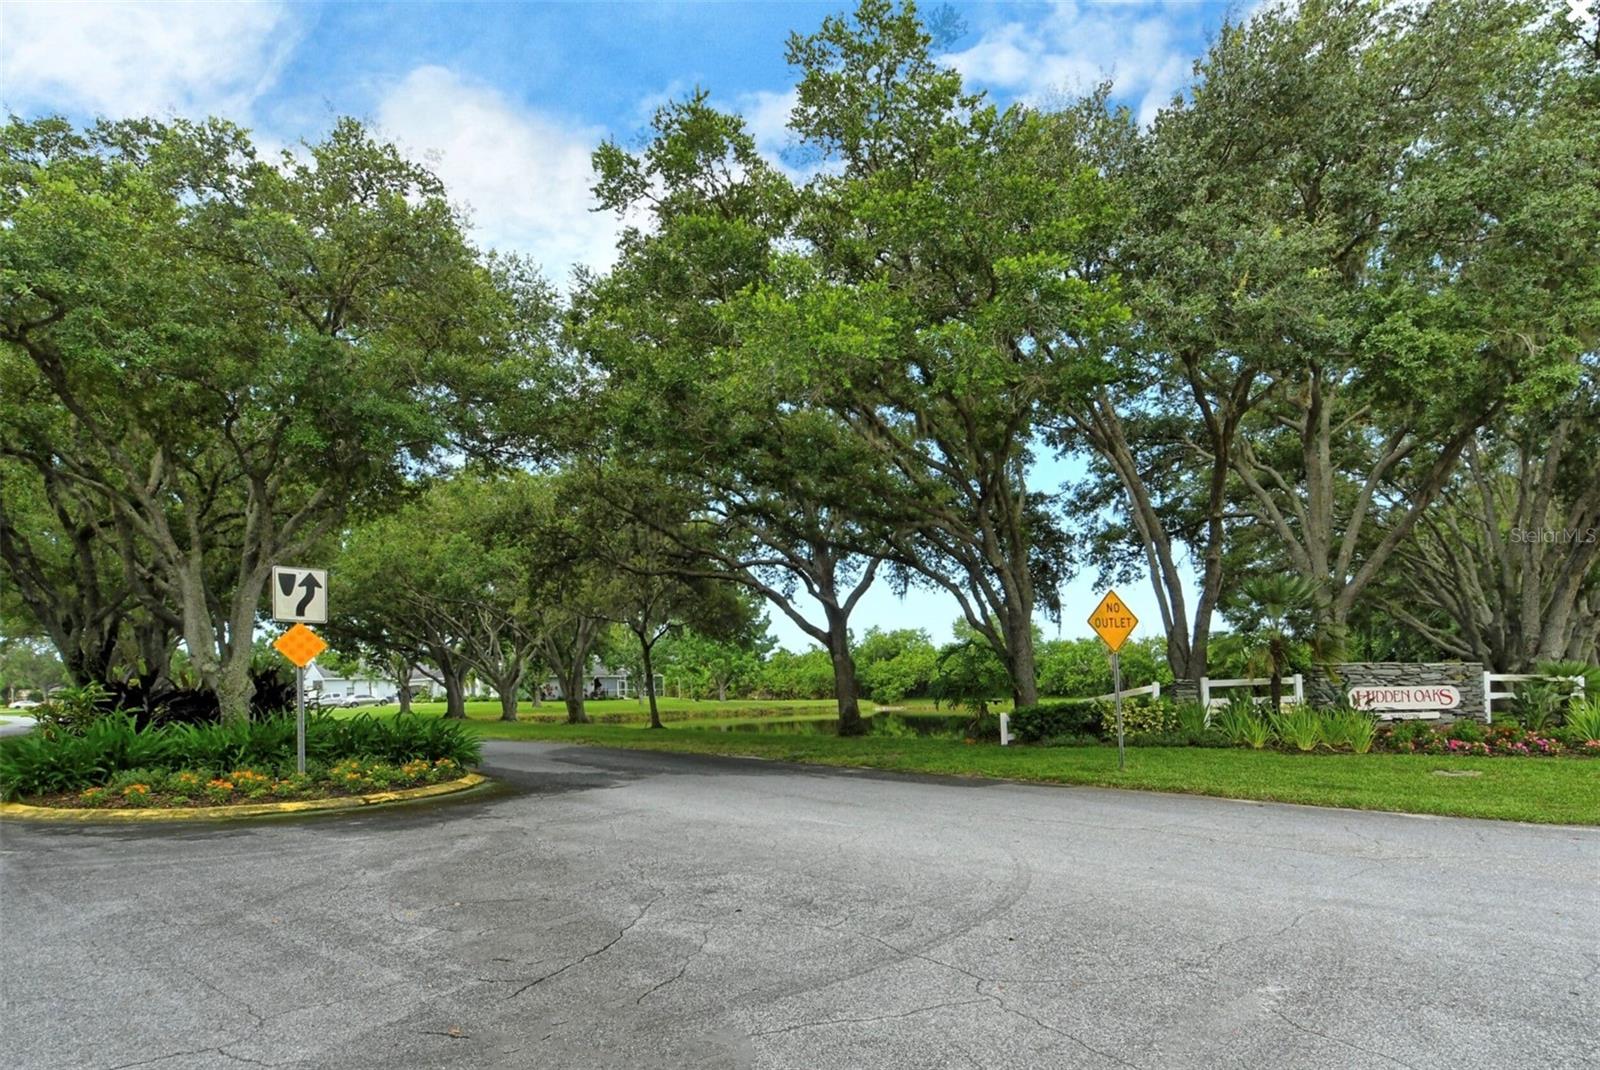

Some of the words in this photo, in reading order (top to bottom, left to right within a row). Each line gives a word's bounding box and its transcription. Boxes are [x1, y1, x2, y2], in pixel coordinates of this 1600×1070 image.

[1106, 602, 1120, 613] NO
[1094, 617, 1131, 629] OUTLET
[1355, 690, 1410, 707] HIDDEN
[1413, 688, 1454, 706] OAKS
